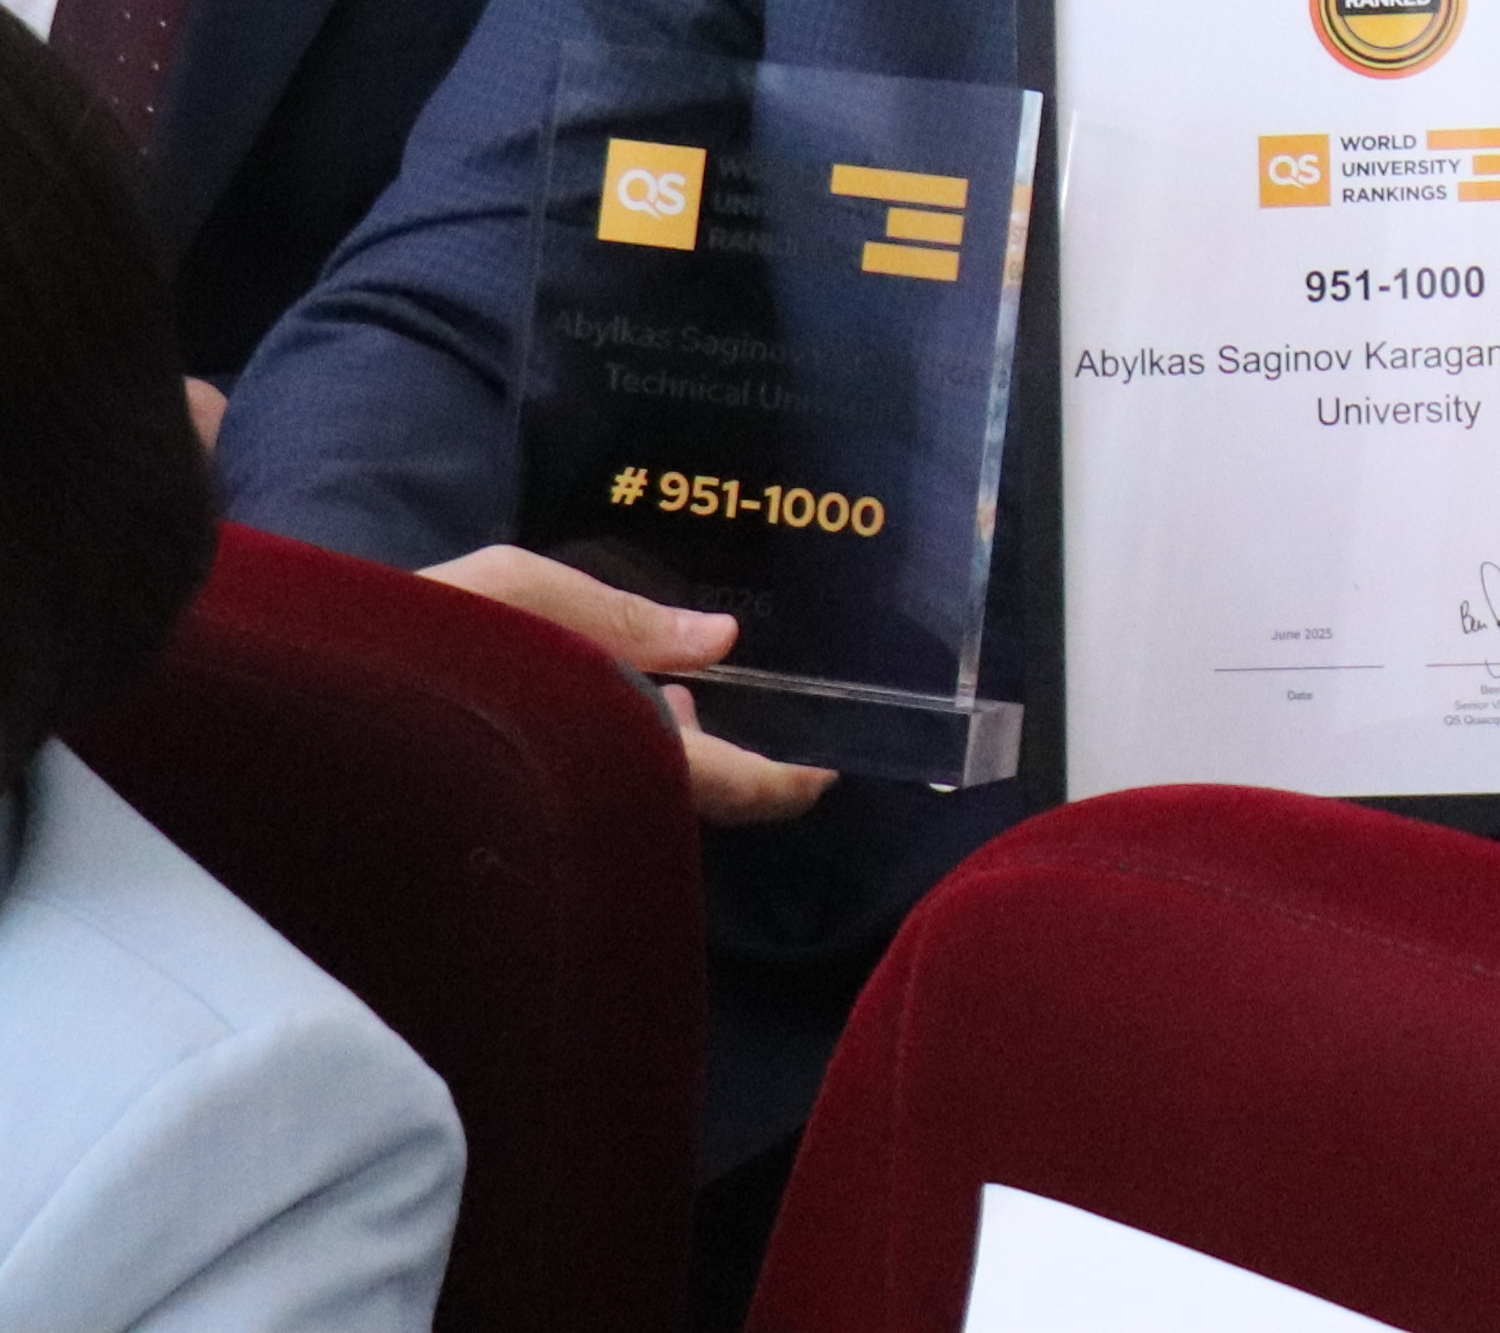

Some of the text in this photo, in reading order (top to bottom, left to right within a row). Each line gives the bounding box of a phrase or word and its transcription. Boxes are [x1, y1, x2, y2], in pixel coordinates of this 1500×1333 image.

[1340, 134, 1417, 152] WORLD
[1268, 154, 1322, 189] QS
[1341, 158, 1462, 177] UNIVERSITY
[617, 168, 687, 221] QS
[1342, 185, 1448, 204] RANKINGS
[1305, 265, 1486, 303] 951-1000
[1074, 347, 1205, 385] Abylkas
[1218, 344, 1352, 380] Saginov
[1317, 394, 1481, 430] University
[610, 466, 885, 538] # 951-1000
[1271, 630, 1301, 641] June
[1286, 690, 1313, 701] Date
